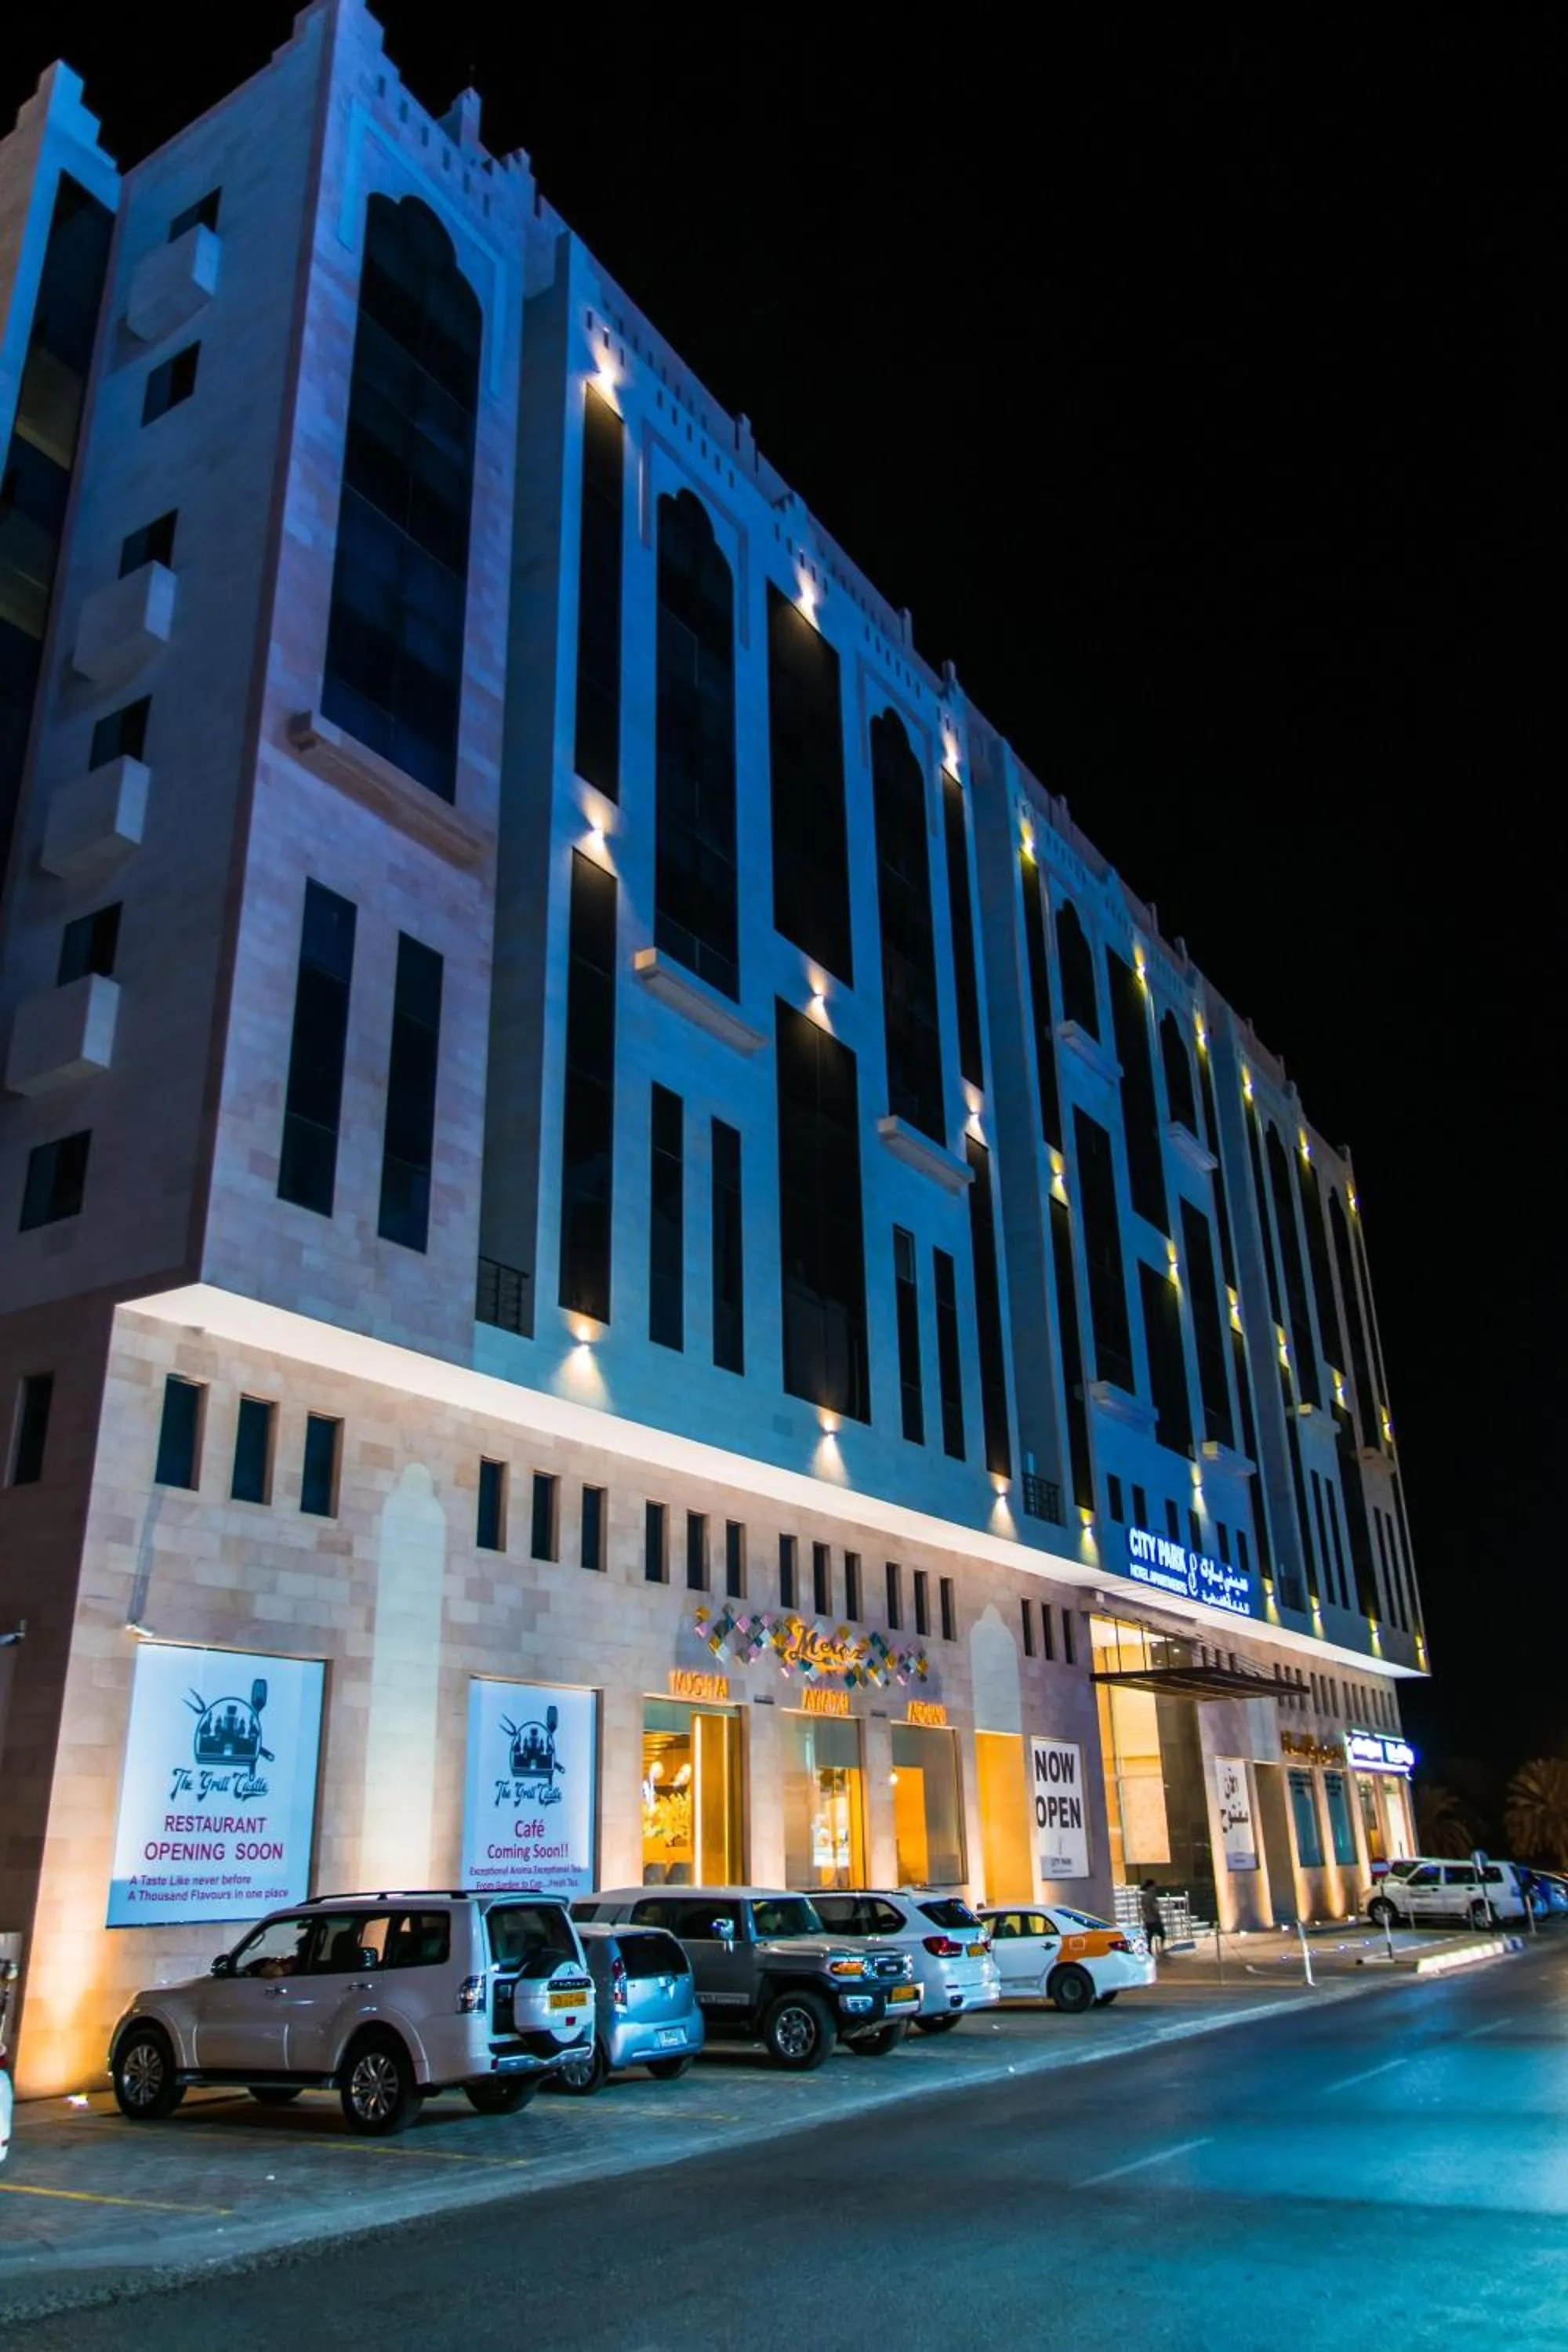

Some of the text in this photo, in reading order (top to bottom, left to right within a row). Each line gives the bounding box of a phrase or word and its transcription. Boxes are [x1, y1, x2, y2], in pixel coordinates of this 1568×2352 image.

[1129, 1527, 1188, 1574] CITY PARK
[1035, 1749, 1074, 1784] NOW
[170, 1768, 268, 1802] The Grill Castle
[495, 1780, 510, 1808] The
[514, 1782, 535, 1807] Grill
[1036, 1795, 1082, 1829] OPEN
[164, 1815, 268, 1834] RESTAURANT
[514, 1818, 545, 1838] Café
[144, 1842, 284, 1861] OPENING SOON
[487, 1842, 569, 1862] Coming Soon!!
[129, 1874, 252, 1886] A Taste Like never before
[127, 1890, 136, 1901] A
[140, 1889, 188, 1901] Thousand
[191, 1889, 231, 1900] Flavours
[235, 1889, 244, 1898] in
[264, 1888, 289, 1900] place
